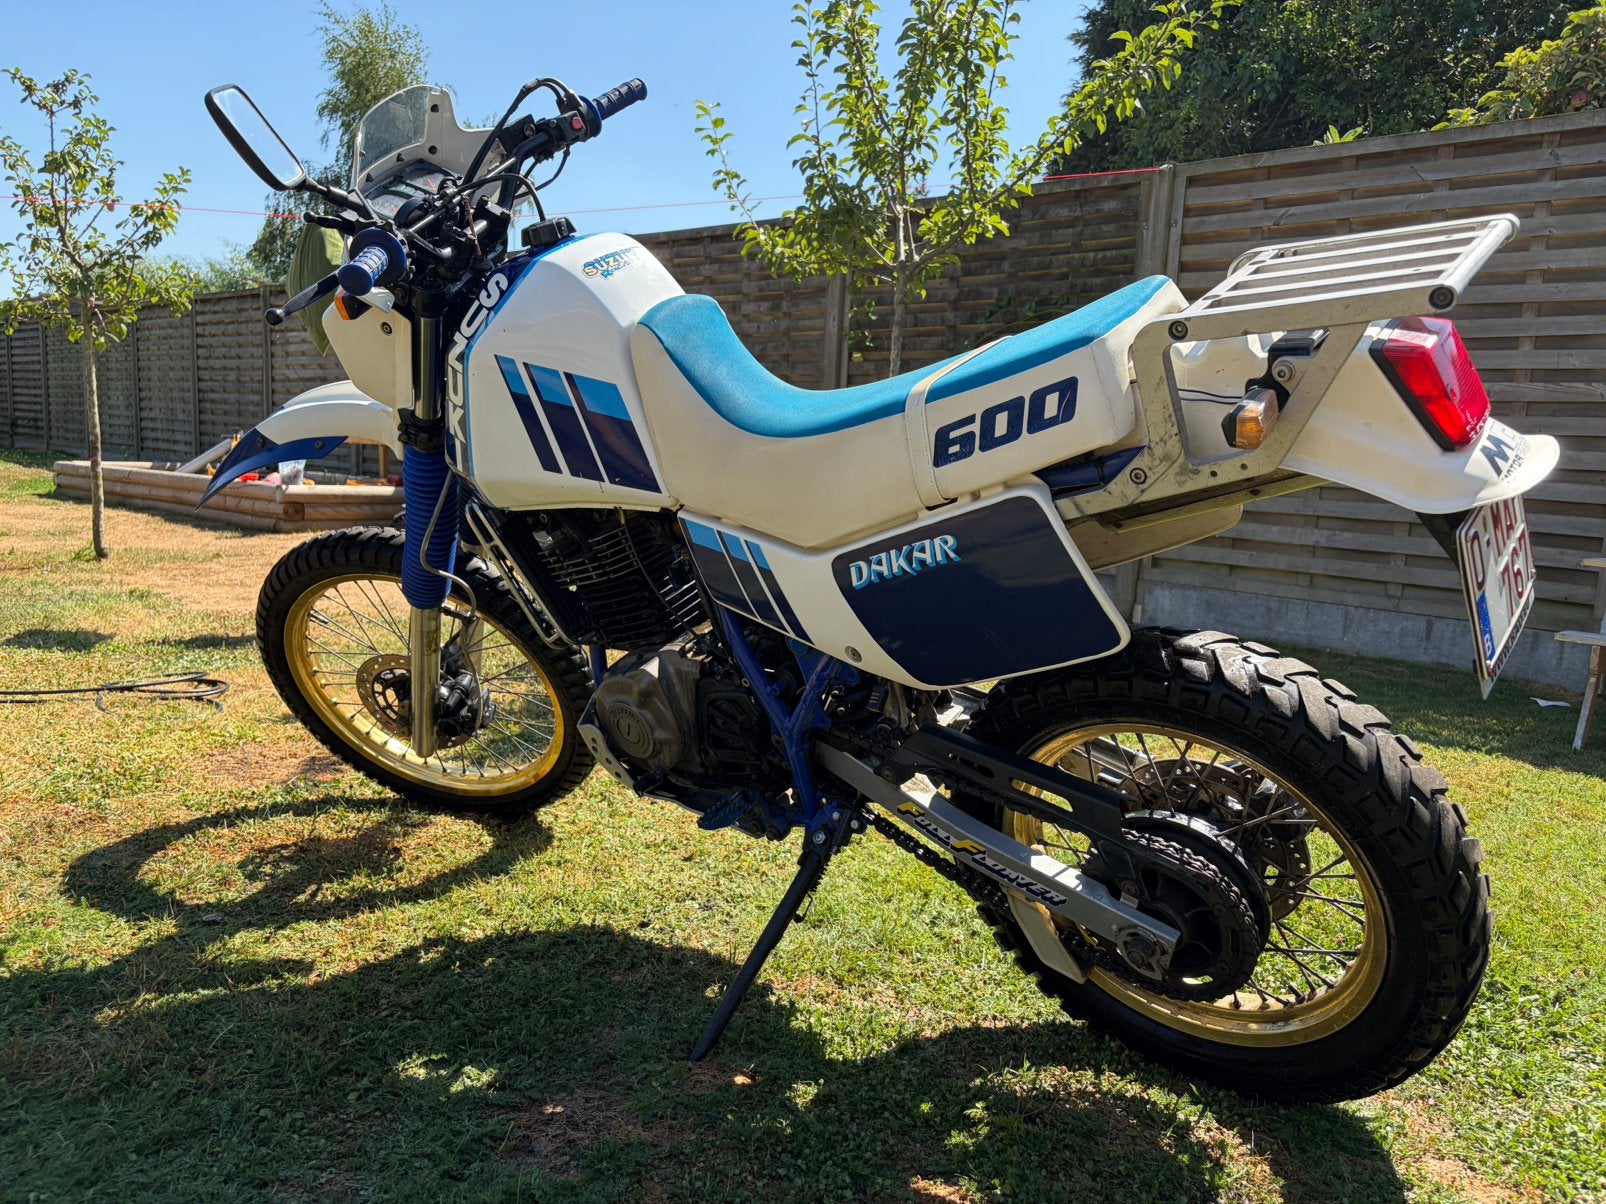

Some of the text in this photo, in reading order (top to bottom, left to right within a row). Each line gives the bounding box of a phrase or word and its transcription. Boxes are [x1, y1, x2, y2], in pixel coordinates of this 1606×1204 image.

[448, 272, 509, 472] SUZUKI
[933, 376, 1079, 468] 600
[849, 534, 962, 590] DAKAR
[1501, 530, 1531, 618] 767
[1484, 633, 1493, 657] B
